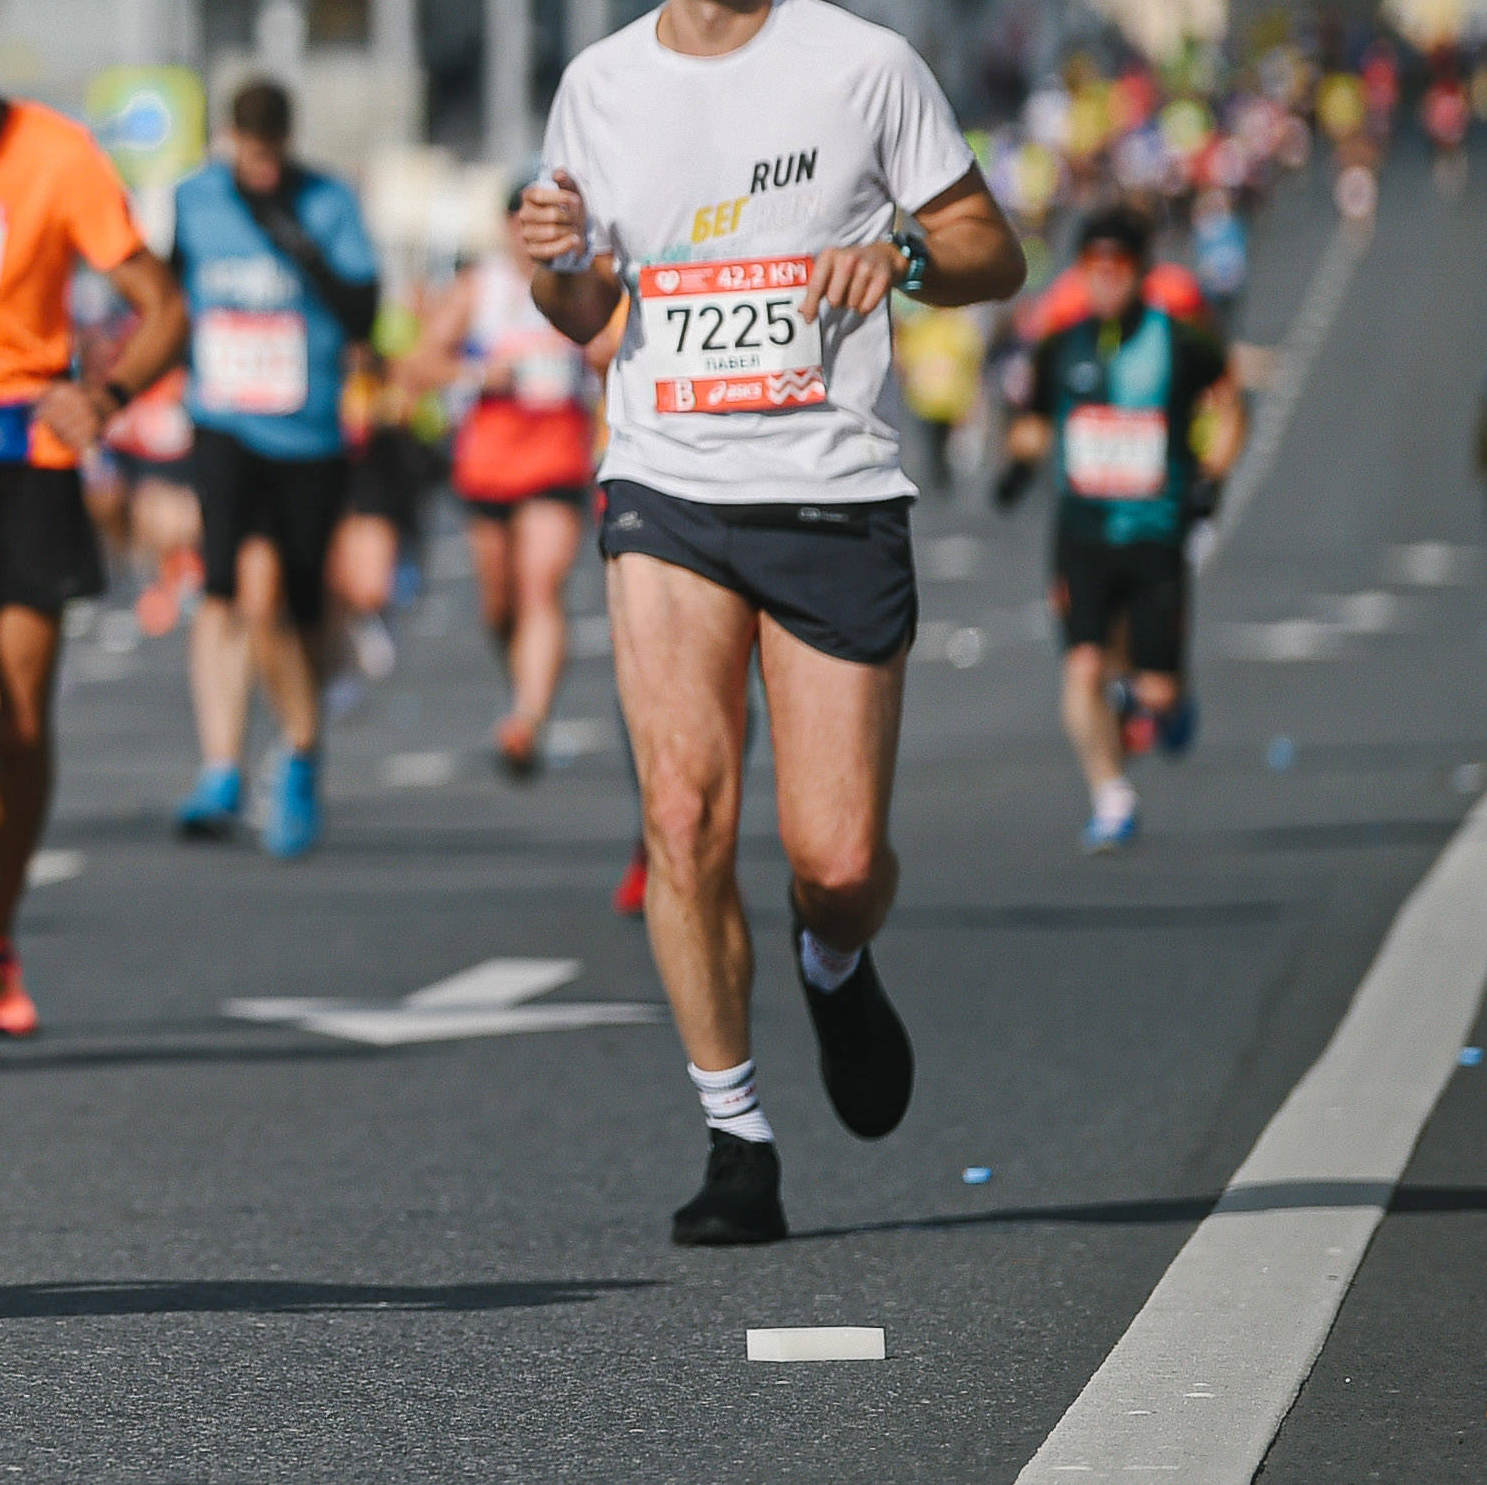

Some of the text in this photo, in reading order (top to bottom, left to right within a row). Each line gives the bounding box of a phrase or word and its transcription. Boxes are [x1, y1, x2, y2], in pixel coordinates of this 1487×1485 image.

[750, 147, 819, 195] RUN
[691, 196, 750, 246] БЕГ
[716, 265, 766, 291] 42,2
[769, 262, 808, 289] KM
[666, 299, 796, 354] 7225
